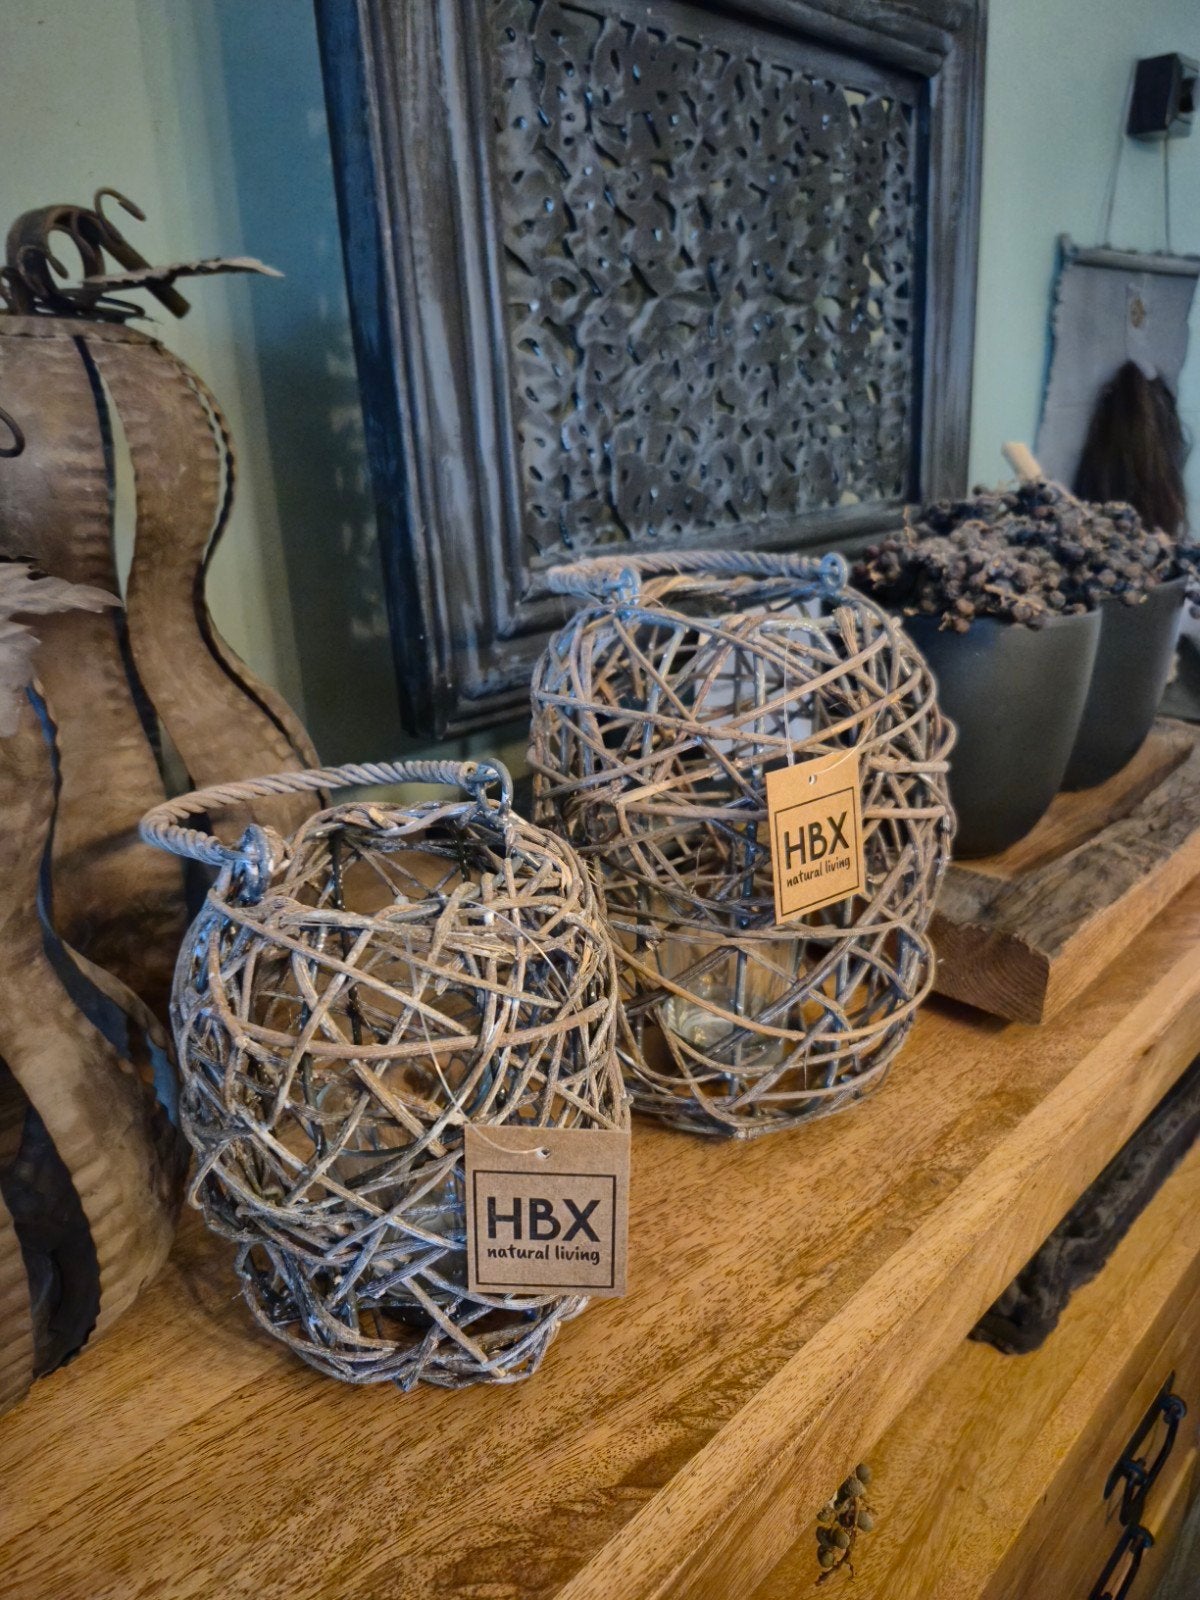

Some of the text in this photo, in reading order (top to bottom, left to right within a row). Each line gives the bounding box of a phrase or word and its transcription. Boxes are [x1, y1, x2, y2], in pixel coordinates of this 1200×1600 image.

[783, 811, 849, 870] HBX
[786, 856, 850, 887] natural living
[487, 1196, 601, 1242] HBX
[487, 1244, 600, 1265] natural living
